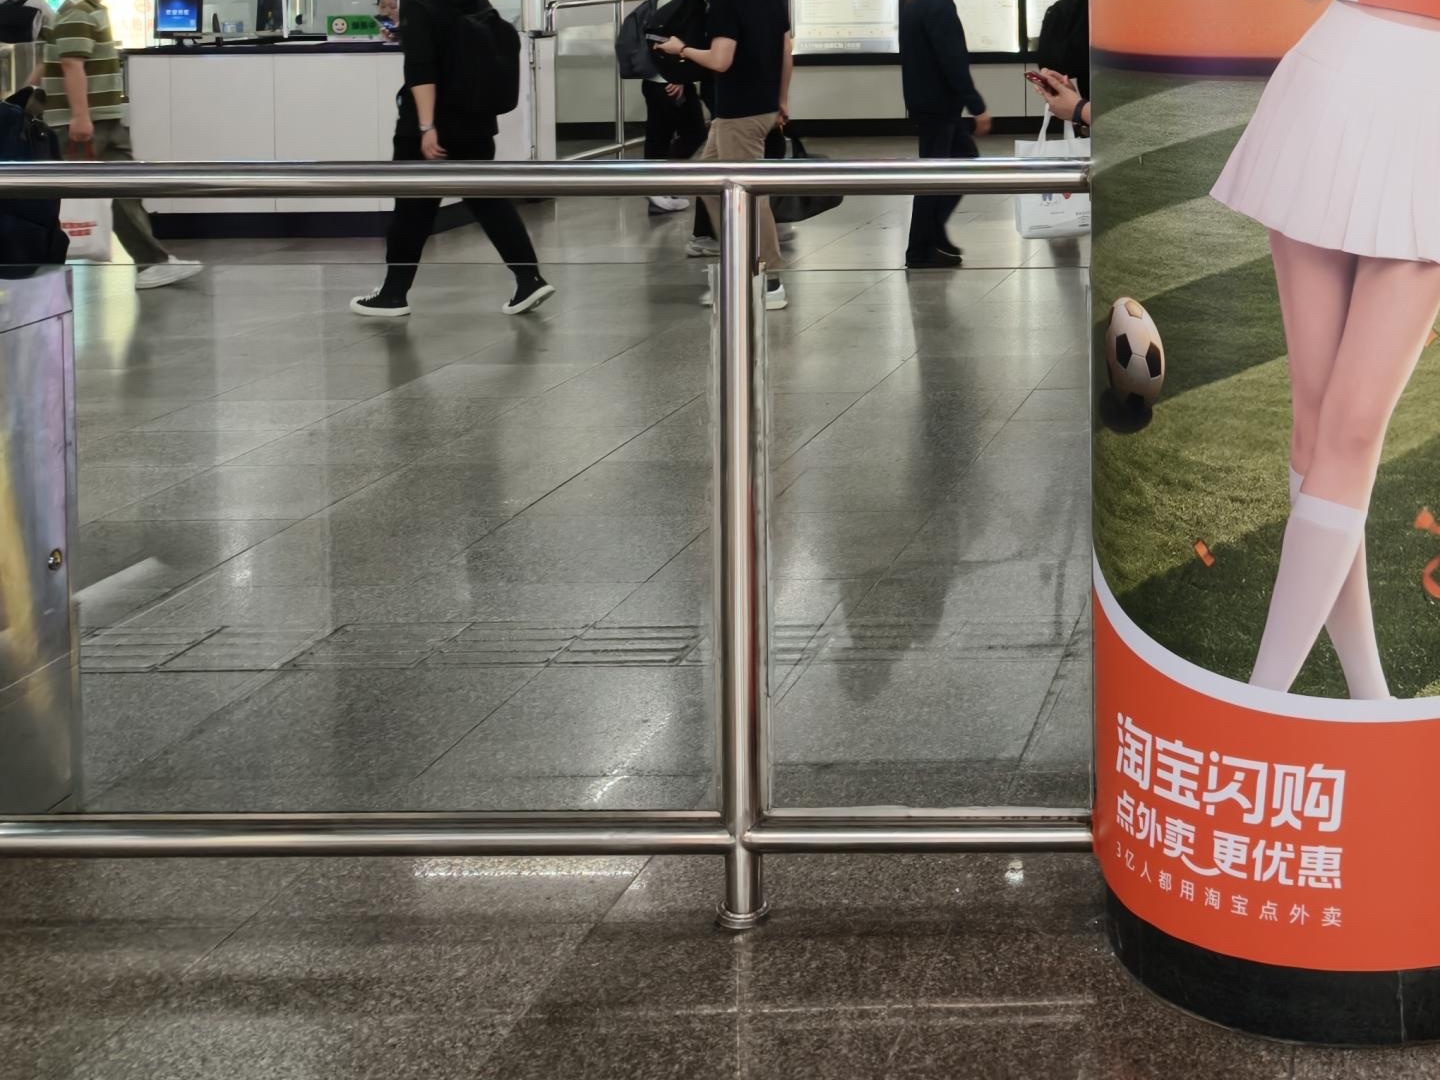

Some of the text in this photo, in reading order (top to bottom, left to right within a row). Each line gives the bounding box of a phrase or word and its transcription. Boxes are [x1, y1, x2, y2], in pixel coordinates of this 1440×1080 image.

[1116, 712, 1346, 833] 淘宝闪购
[1115, 841, 1343, 928] 3亿人都用淘宝点外卖
[1116, 789, 1344, 889] 点外卖 更优惠
